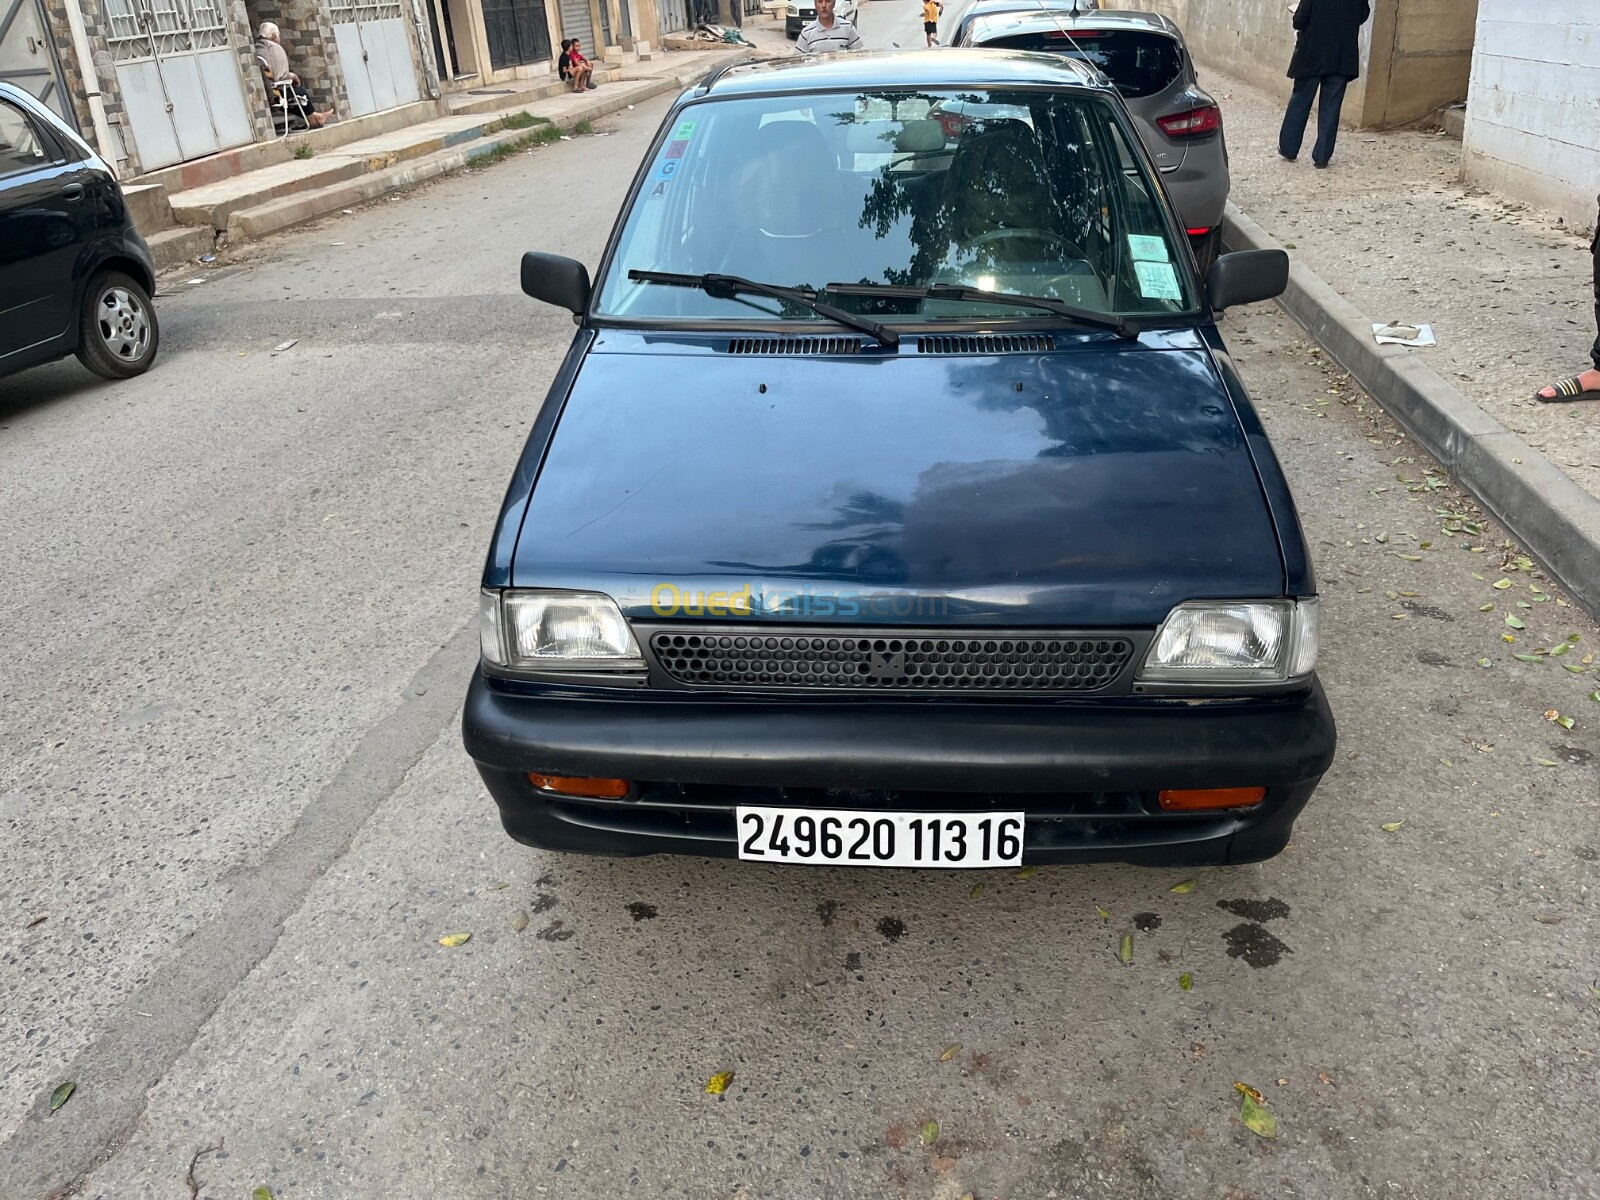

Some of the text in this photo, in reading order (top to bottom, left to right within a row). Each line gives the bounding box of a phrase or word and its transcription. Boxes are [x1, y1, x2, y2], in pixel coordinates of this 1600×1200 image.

[662, 161, 675, 175] G
[652, 181, 664, 195] A
[742, 813, 1021, 861] 249620 113 16
